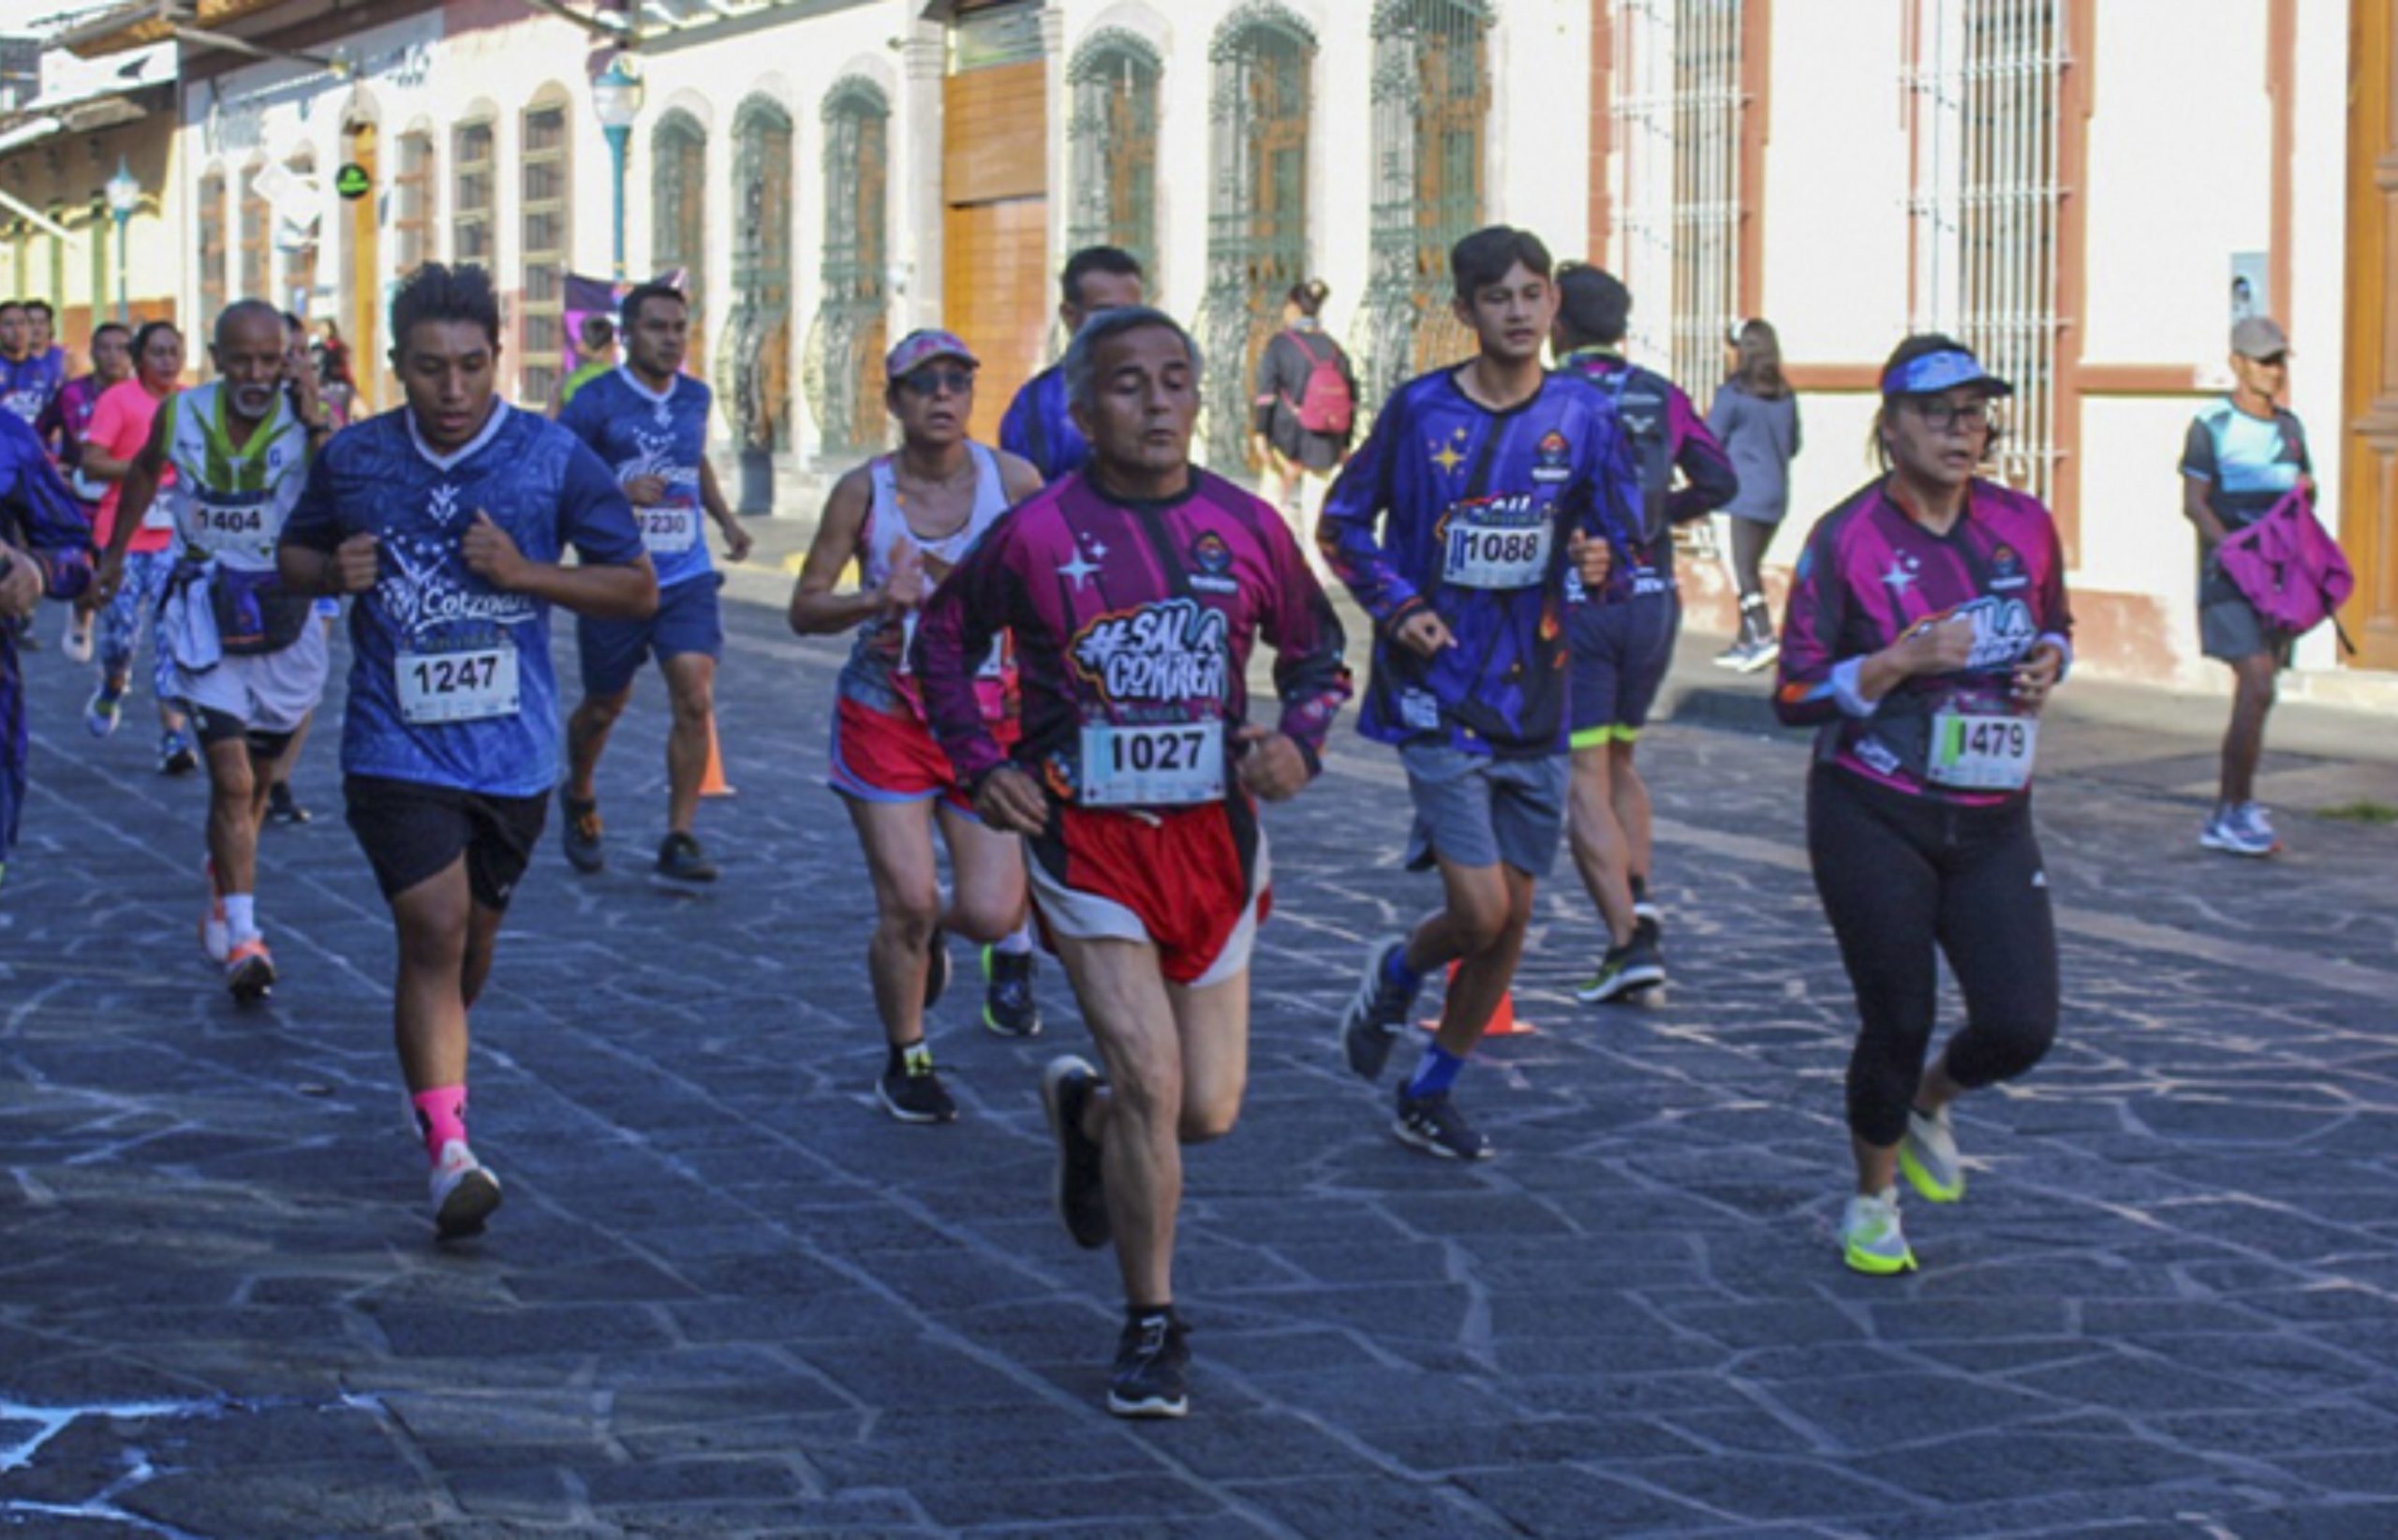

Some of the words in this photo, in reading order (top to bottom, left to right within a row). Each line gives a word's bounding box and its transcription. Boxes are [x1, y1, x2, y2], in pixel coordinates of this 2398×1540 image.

[197, 509, 260, 532] 1404
[1469, 532, 1538, 562] 1088
[413, 658, 497, 694] 1247
[1112, 733, 1205, 772] 1027
